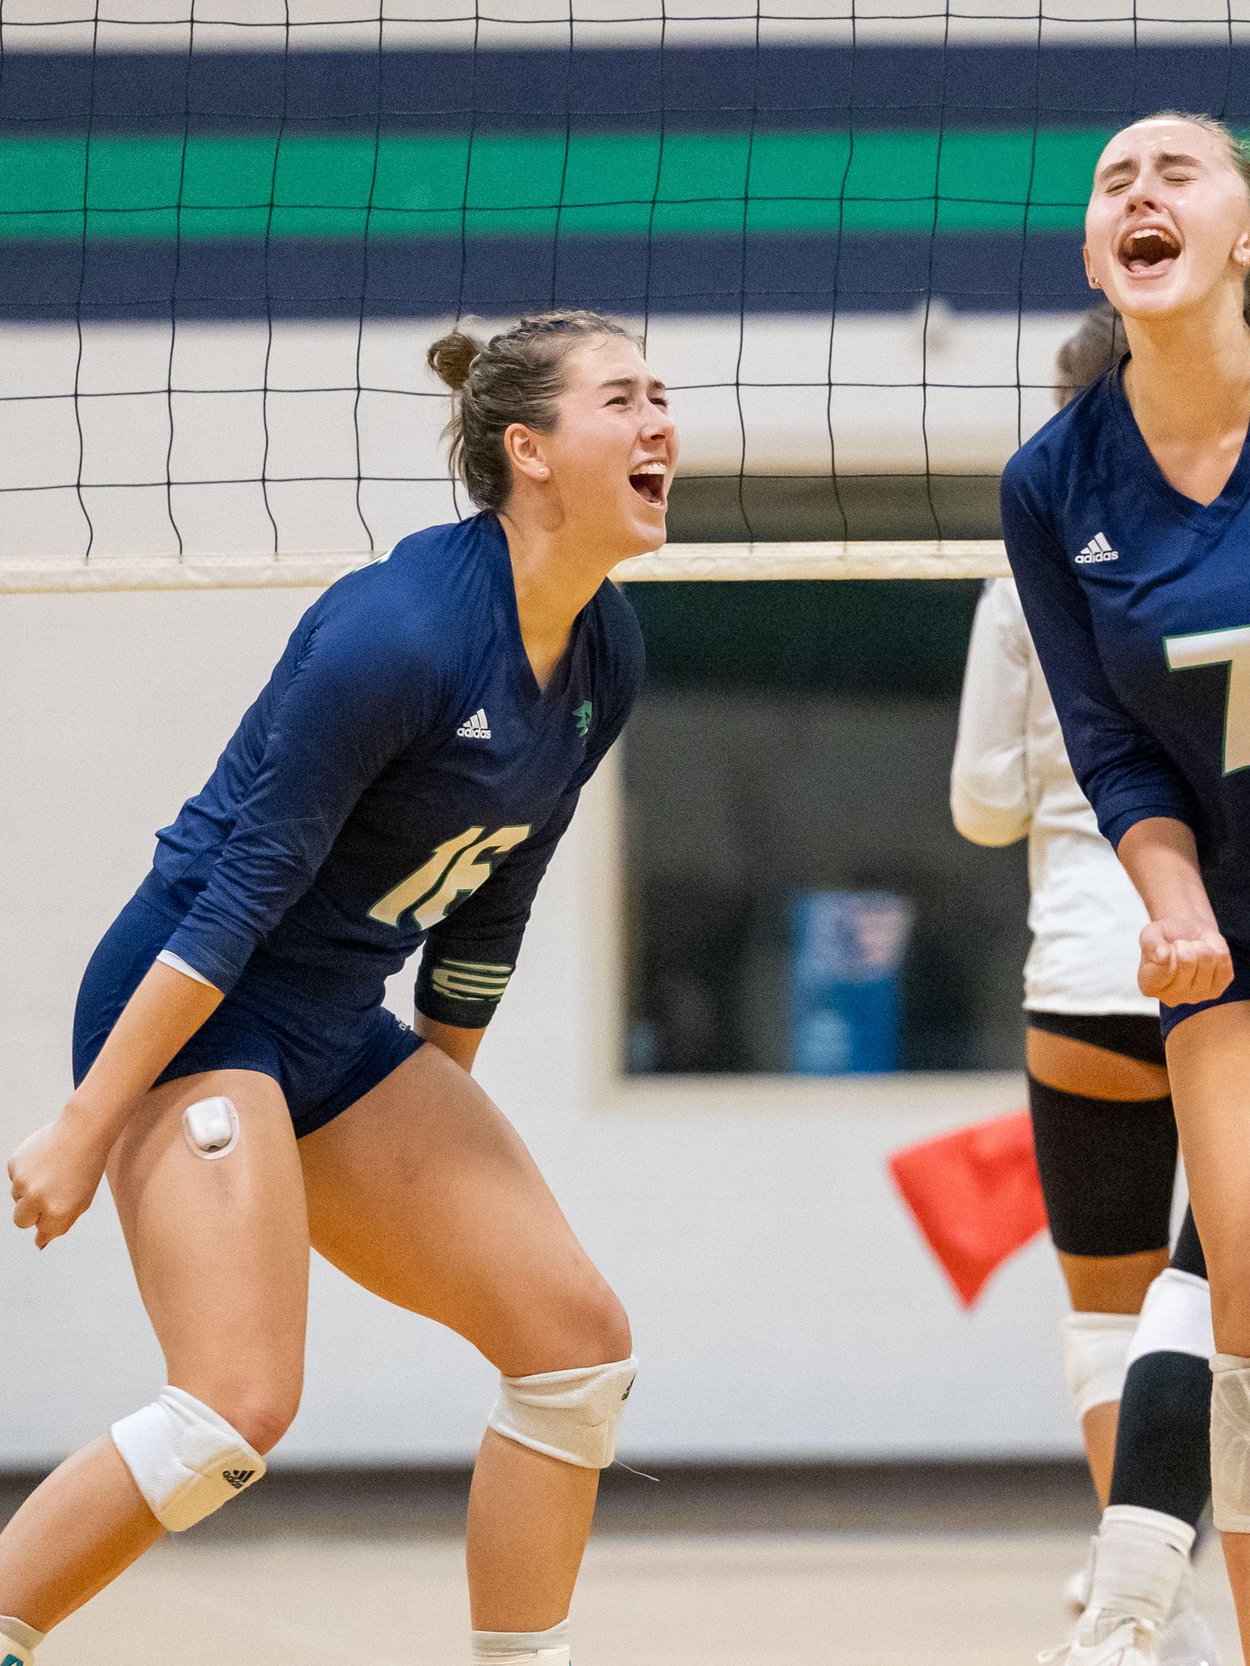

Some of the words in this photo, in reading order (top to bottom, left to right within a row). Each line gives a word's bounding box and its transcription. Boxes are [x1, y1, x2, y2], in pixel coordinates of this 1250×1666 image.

[1075, 550, 1119, 564] adidas
[456, 727, 492, 740] adidas
[368, 823, 532, 931] 16
